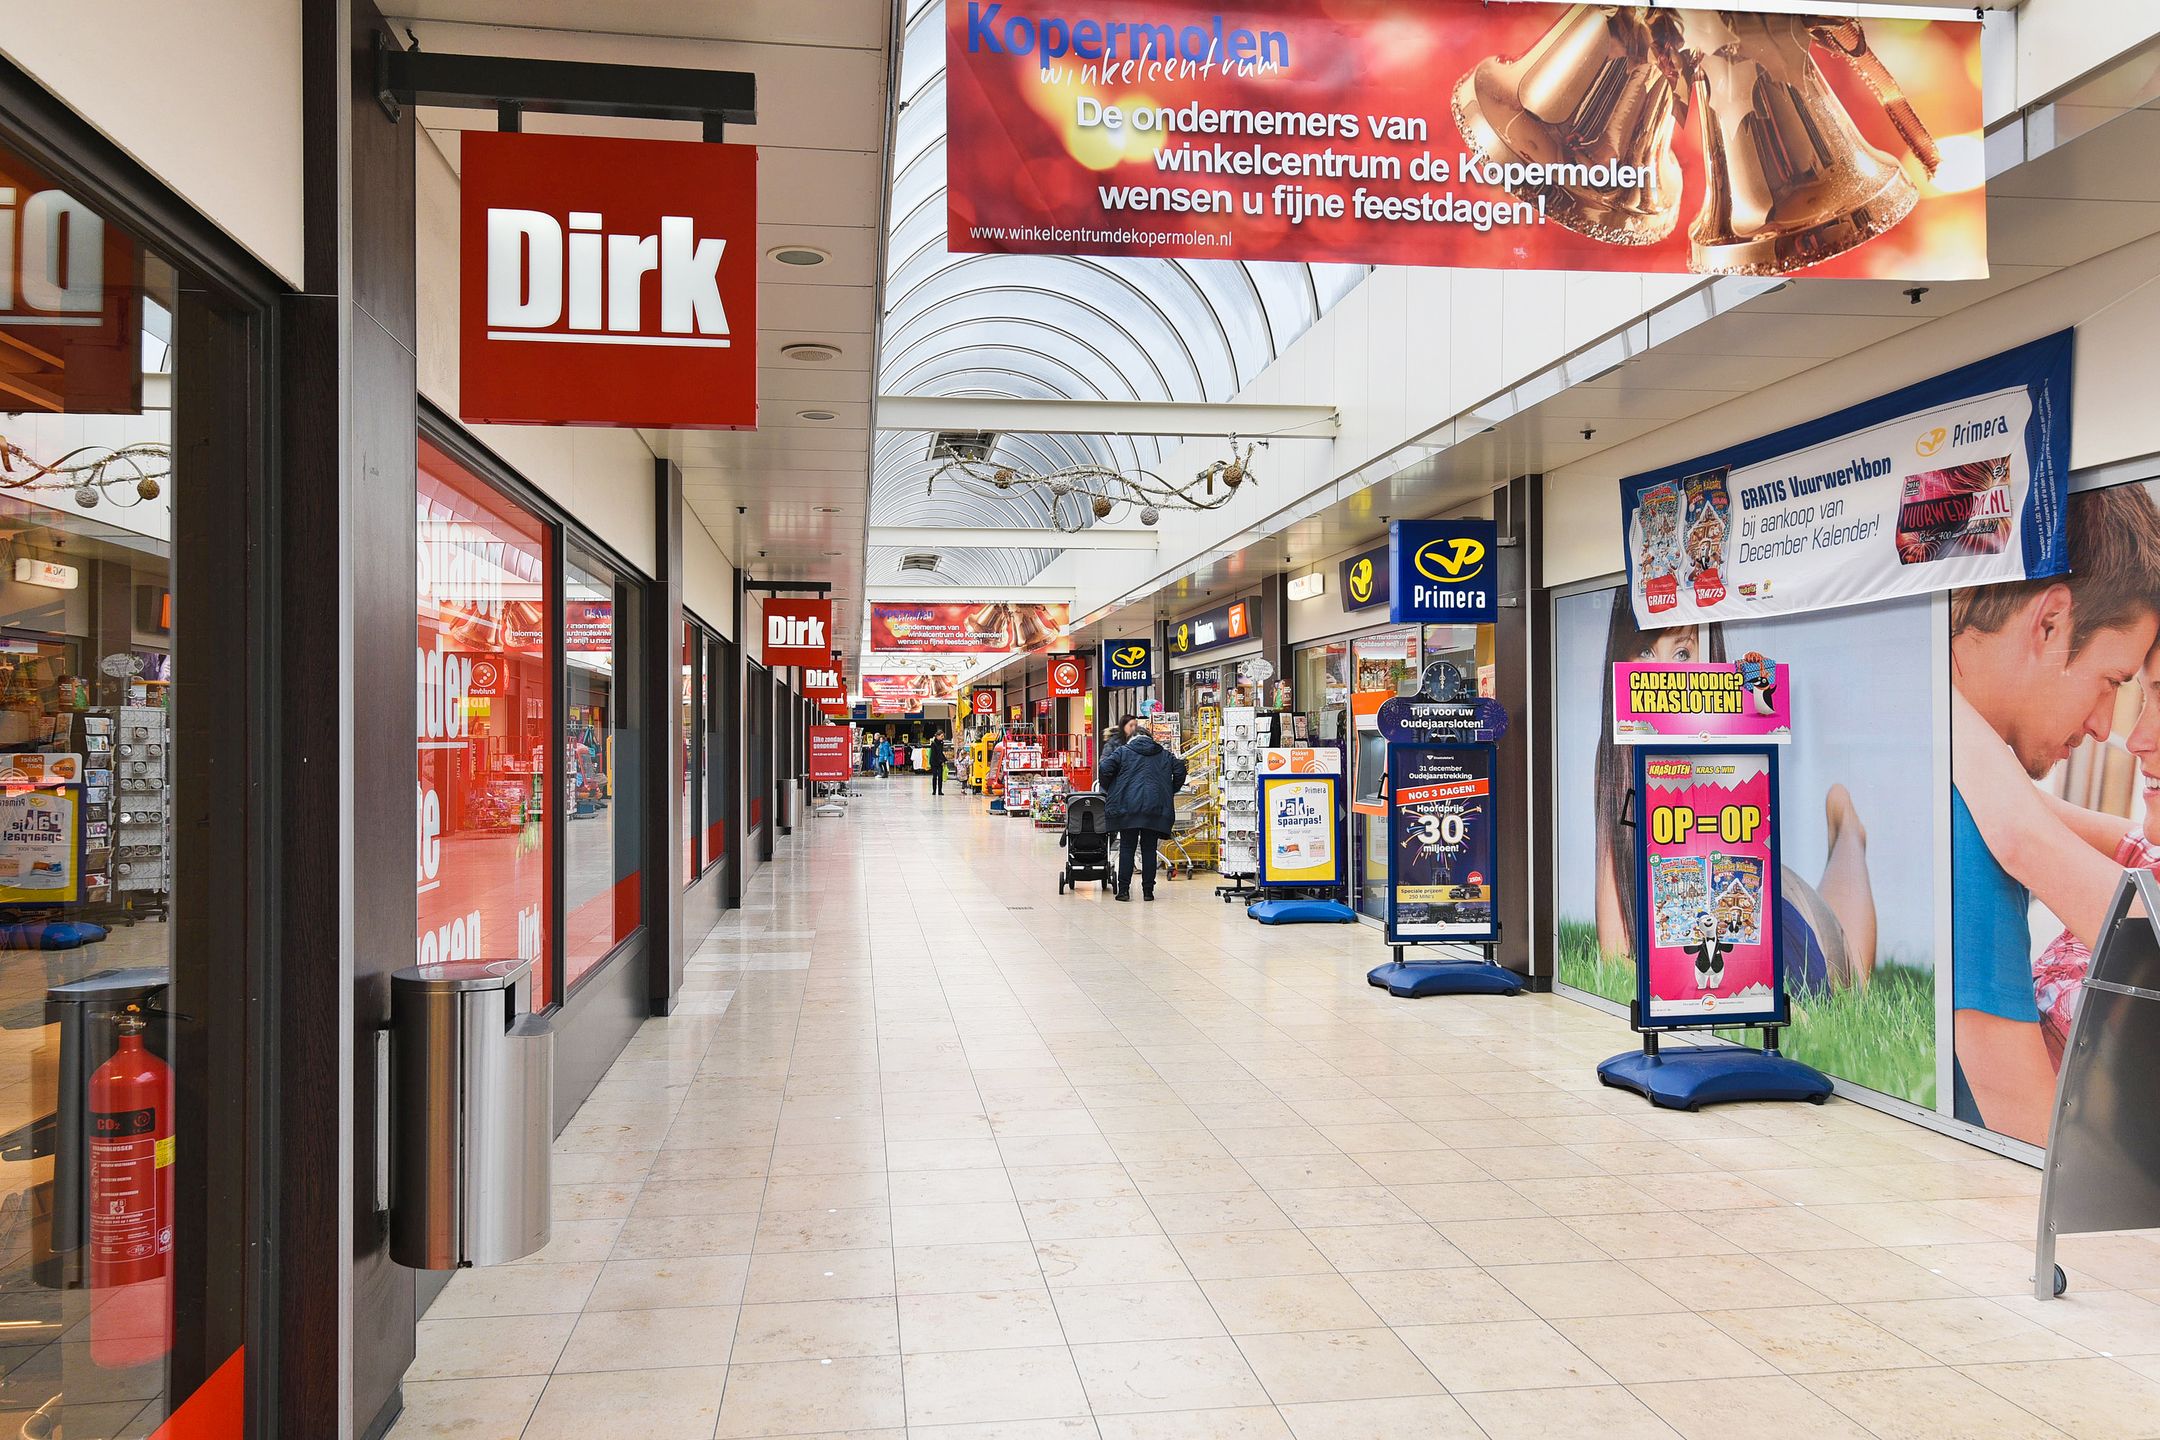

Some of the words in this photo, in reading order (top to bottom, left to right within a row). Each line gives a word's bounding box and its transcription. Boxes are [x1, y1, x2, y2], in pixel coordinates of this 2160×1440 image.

[967, 2, 1289, 69] Kopermolen
[1039, 38, 1279, 87] winkelcentrum
[1076, 97, 1123, 130] De
[1131, 102, 1360, 141] ondernemers
[1367, 112, 1427, 142] van
[1153, 142, 1400, 181] winkelcentrum
[1409, 151, 1450, 183] de
[1458, 153, 1657, 191] Kopermolen
[1099, 184, 1234, 214] wensen
[1242, 190, 1263, 215] u
[1273, 188, 1345, 224] fijne
[1353, 190, 1546, 229] feestdagen!
[969, 225, 1233, 249] www.winkelcentrumdekopermolen.nl
[487, 207, 731, 335] Dirk
[1952, 415, 2008, 448] Primera
[1740, 479, 1787, 510] GRATIS
[1788, 457, 1891, 498] Vuurwerkbon
[1742, 515, 1756, 539] bij
[1760, 506, 1815, 533] aankoop
[1819, 499, 1844, 520] van
[1739, 534, 1808, 563] December
[1812, 513, 1880, 550] Kalender!
[1414, 585, 1486, 609] Primera
[1648, 593, 1676, 607] GRATIS
[1696, 587, 1724, 600] GRATIS
[768, 615, 826, 646] Dirk
[805, 669, 839, 686] Dirk
[1111, 668, 1147, 681] Primera
[1629, 672, 1688, 691] CADEAU
[1689, 672, 1744, 691] NODIG?
[1055, 687, 1080, 695] Kruidvat
[1630, 690, 1744, 714] KRASLOTEN!
[1410, 707, 1430, 717] Tijd
[1432, 708, 1456, 716] voor
[1458, 708, 1474, 716] uw
[1400, 719, 1484, 729] Oudejaarsloten!
[1648, 764, 1691, 775] KRASLOTEN
[1695, 766, 1714, 774] KRAS
[1721, 766, 1736, 774] WIN
[1305, 786, 1327, 794] Primera
[1408, 790, 1430, 800] NOG
[1431, 788, 1438, 797] 3
[1440, 784, 1476, 796] DAGEN!
[1306, 805, 1315, 816] je
[1416, 804, 1465, 815] Hoofdprijs
[1277, 815, 1322, 828] spaarpas!
[1416, 814, 1465, 845] 30
[1651, 804, 1762, 845] OP=OP
[1423, 844, 1459, 854] miljoen!
[1710, 853, 1721, 862] €10
[1650, 856, 1660, 864] €5
